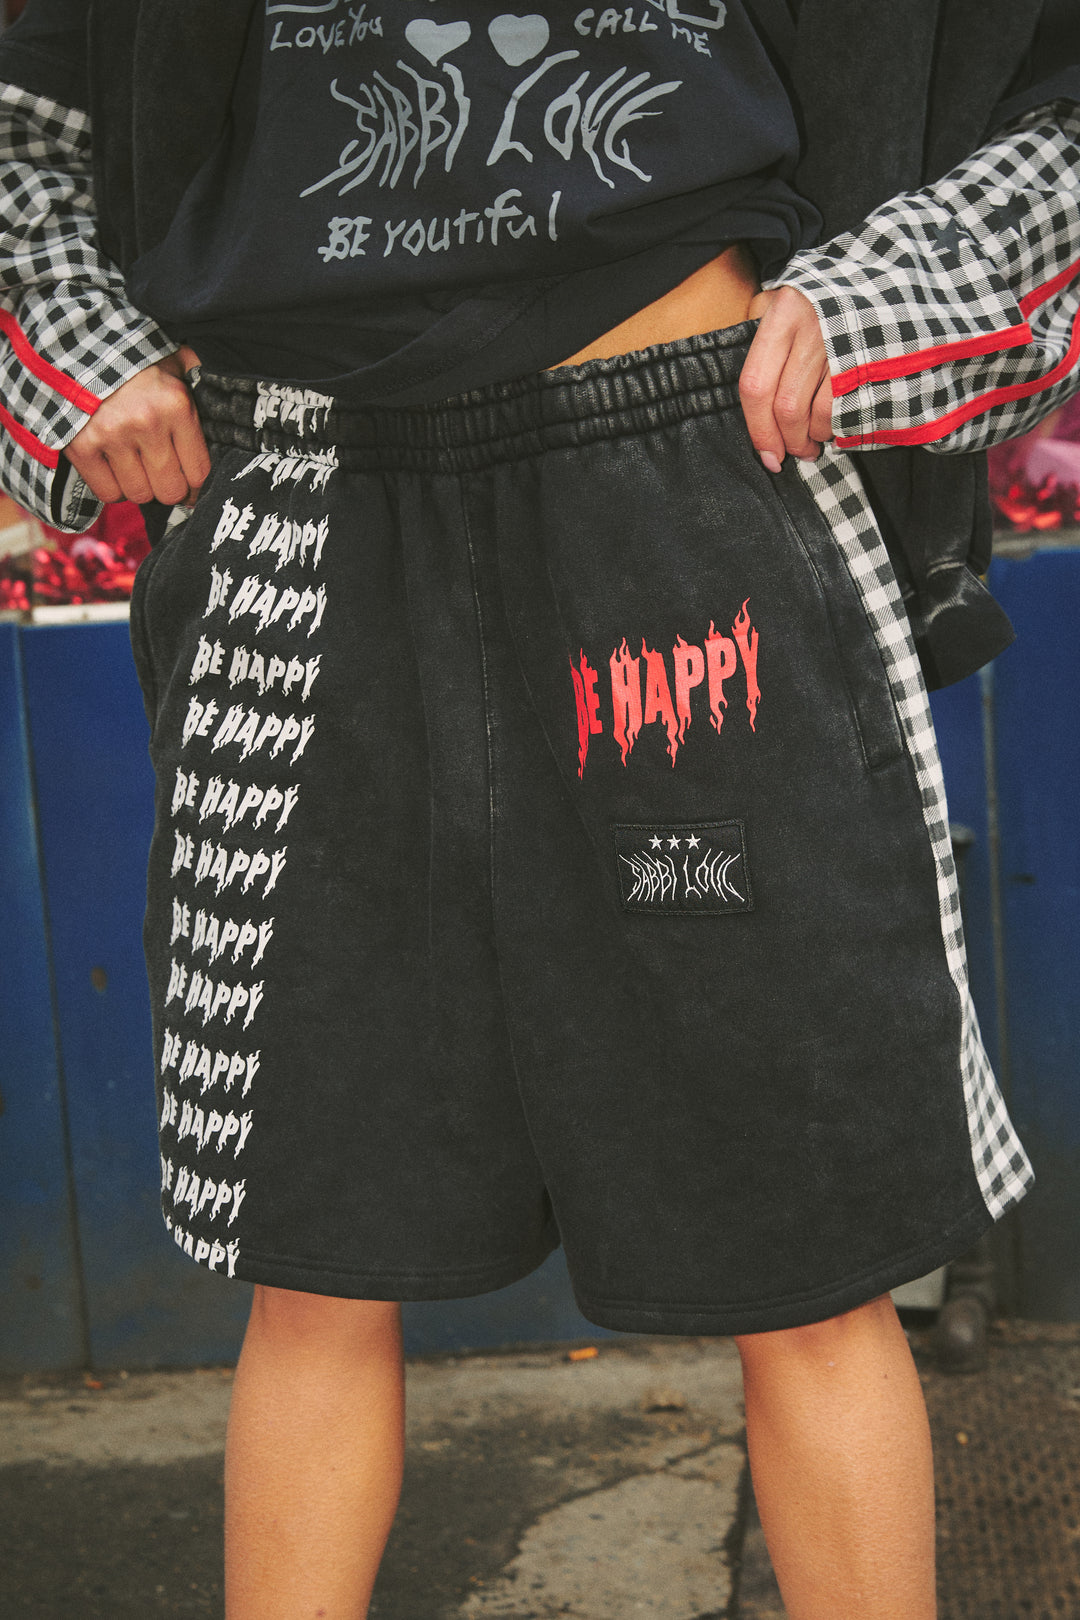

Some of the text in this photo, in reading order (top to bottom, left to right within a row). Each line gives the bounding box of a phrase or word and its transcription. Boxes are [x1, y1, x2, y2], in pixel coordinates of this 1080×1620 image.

[271, 21, 346, 55] LOVE
[574, 8, 712, 58] CALL ME
[486, 49, 684, 190] LOVE
[317, 215, 373, 263] BE
[208, 496, 330, 574] BE HAPPY
[201, 562, 328, 639] BE HAPPY
[187, 633, 323, 704] BE HAPPY
[568, 596, 762, 781] BE HAPPY
[180, 694, 316, 767] BE HAPPY
[170, 764, 301, 835] BE HAPPY
[169, 827, 288, 901] BE HAPPY
[168, 895, 276, 971] BE HAPPY
[163, 956, 265, 1032] BE HAPPY
[160, 1026, 262, 1100] BE HAPPY
[177, 1098, 254, 1161] HAPPY
[172, 1165, 247, 1229] HAPPY
